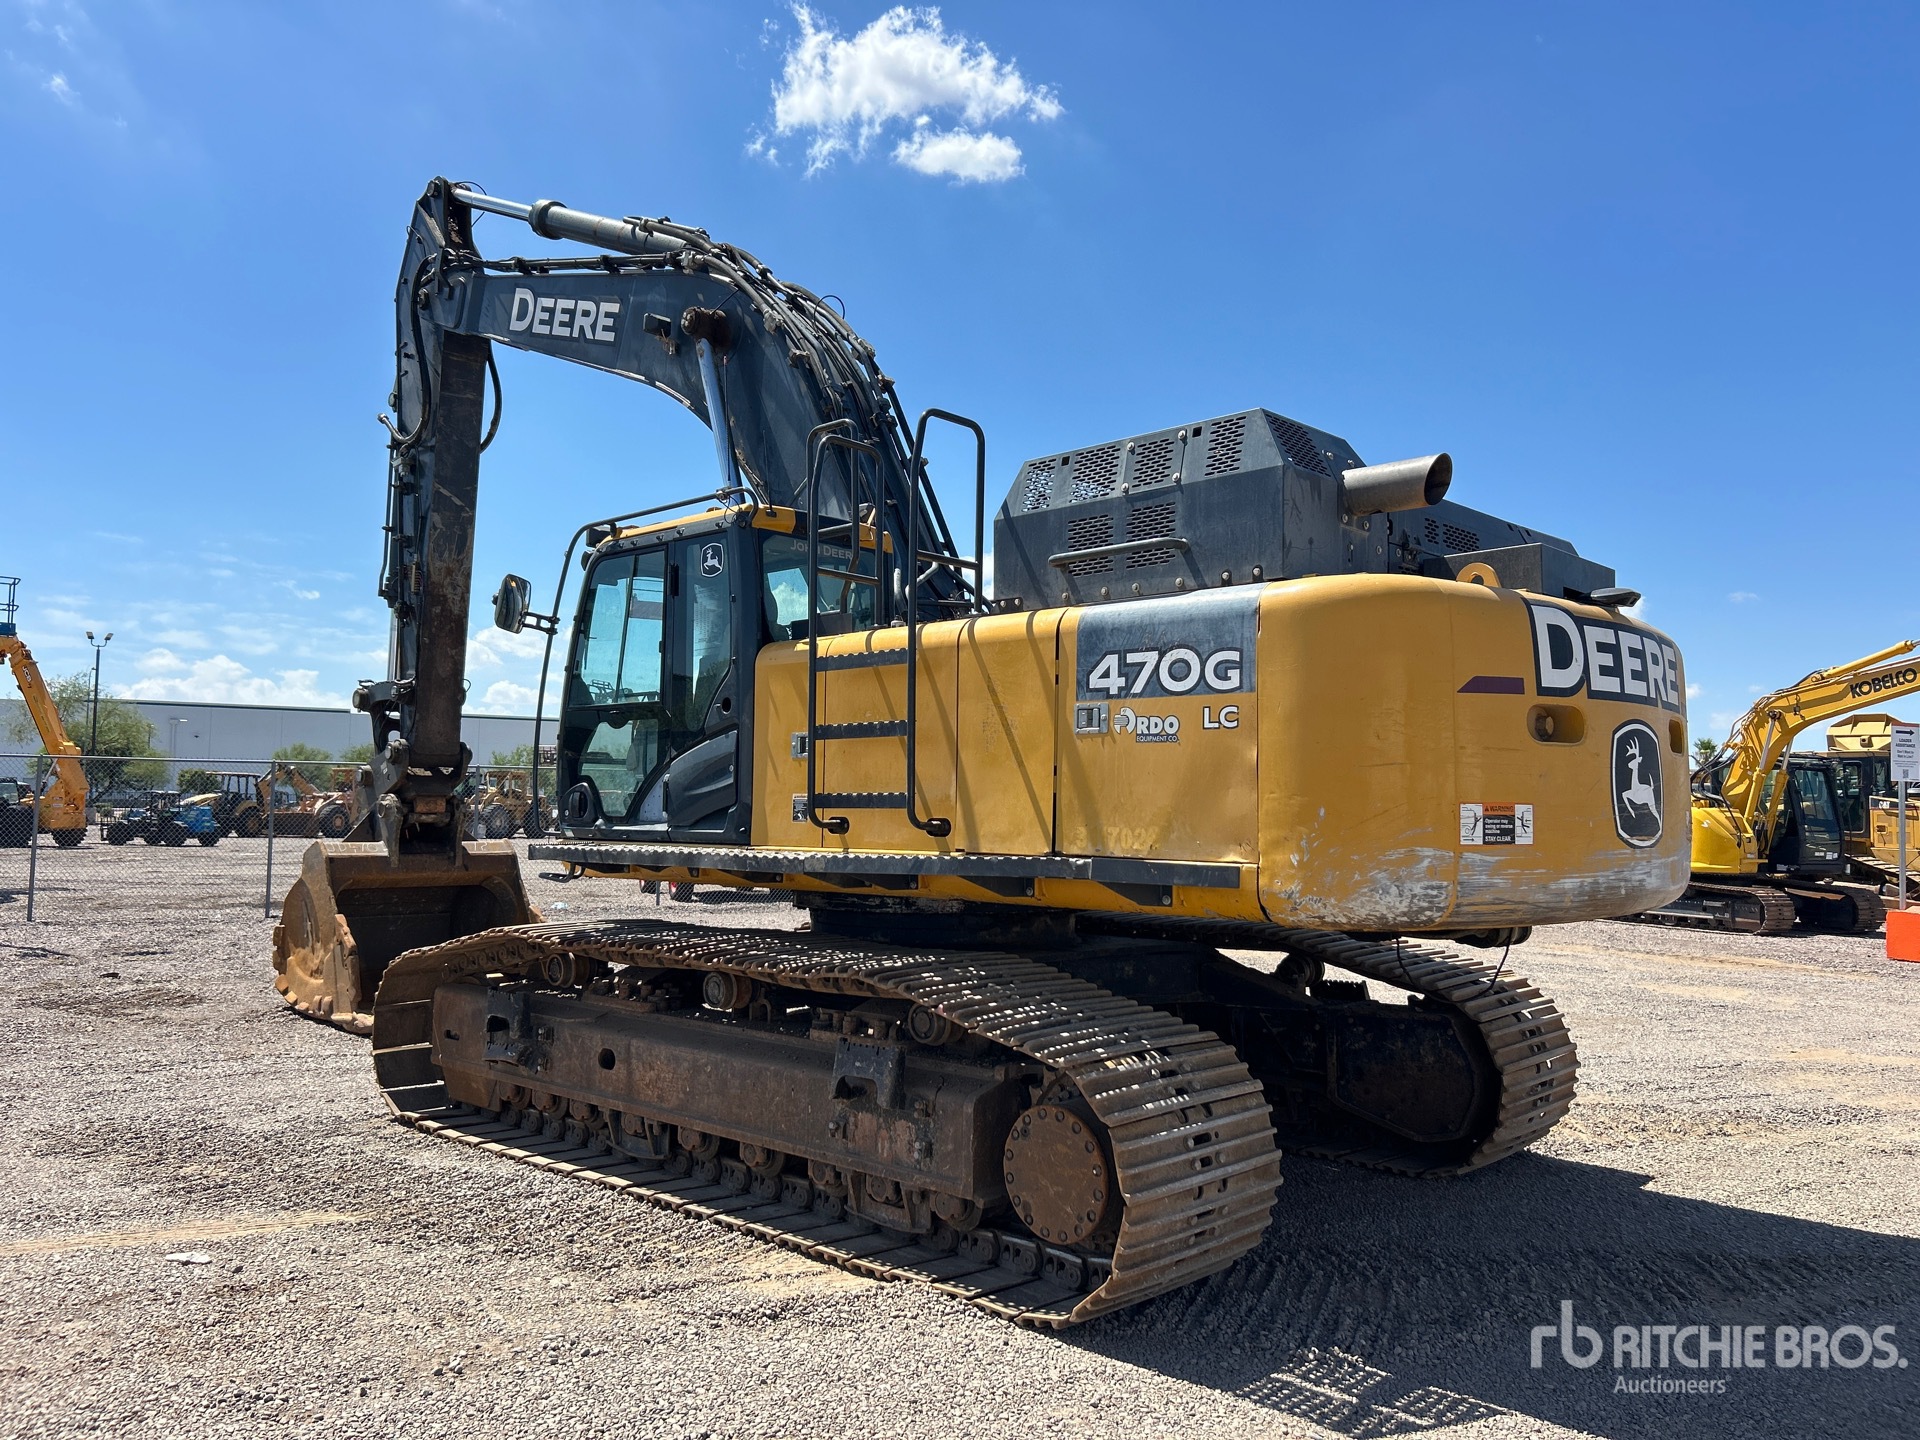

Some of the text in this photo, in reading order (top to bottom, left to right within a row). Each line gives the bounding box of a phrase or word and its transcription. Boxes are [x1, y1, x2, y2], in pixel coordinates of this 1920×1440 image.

[509, 287, 621, 342] DEERE
[790, 540, 853, 560] JO DEER
[1088, 647, 1241, 696] 470G
[1530, 604, 1680, 706] DEERE
[1849, 667, 1918, 699] KOBELCO
[1203, 706, 1239, 729] LC
